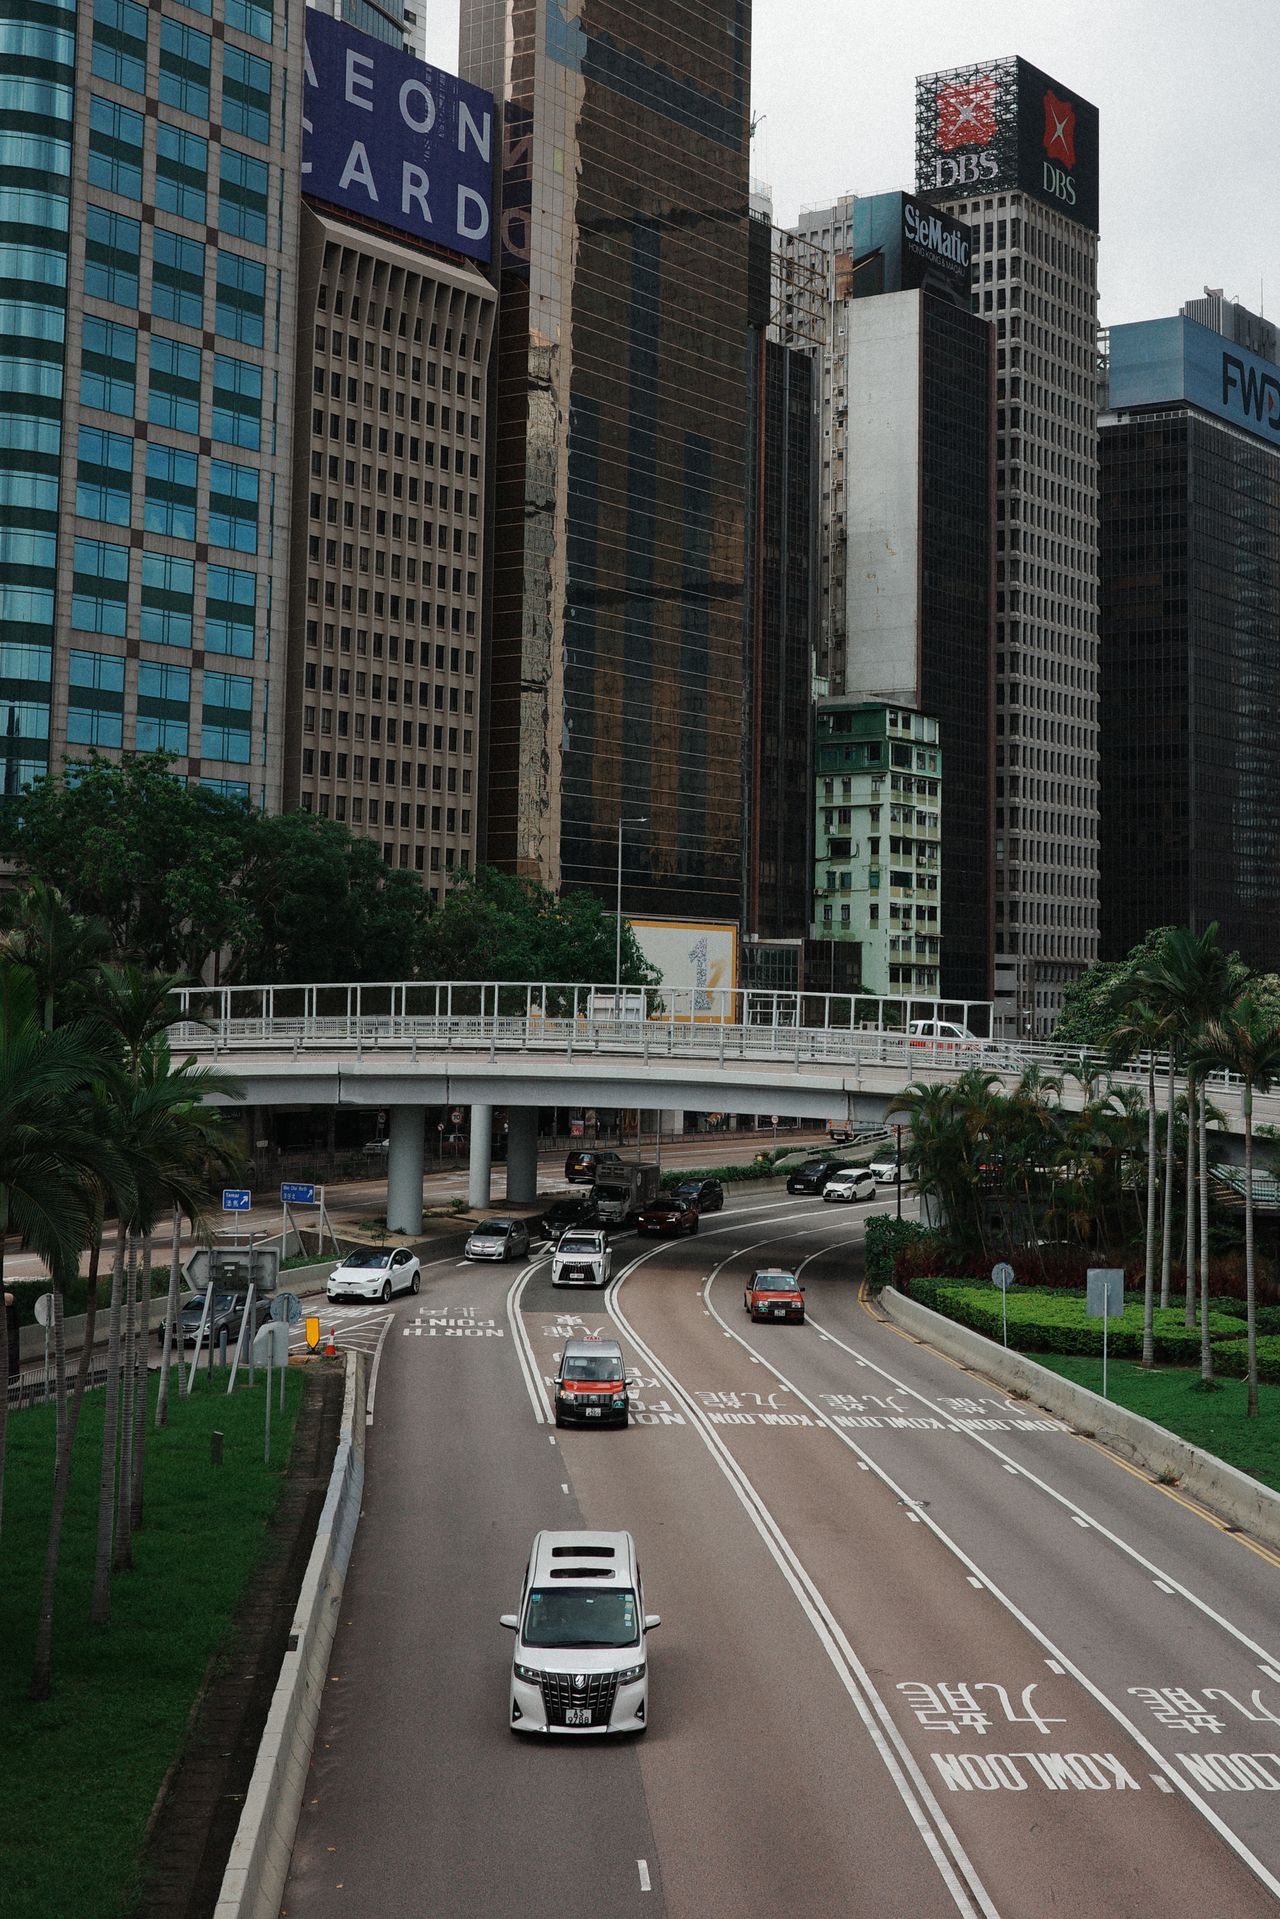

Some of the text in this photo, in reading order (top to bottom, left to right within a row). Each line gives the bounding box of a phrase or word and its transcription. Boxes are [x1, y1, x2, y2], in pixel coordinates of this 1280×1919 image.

[935, 150, 998, 188] DBS
[1043, 161, 1076, 206] DBS
[904, 204, 969, 267] SieMatic
[1223, 351, 1280, 430] FWD
[402, 1328, 504, 1337] NORTH
[409, 1318, 495, 1327] POINT
[694, 1391, 788, 1409] 九龍
[819, 1393, 908, 1413] 九龍
[707, 1412, 815, 1427] KOWLOON
[832, 1415, 946, 1430] KOWLOON
[956, 1418, 1075, 1433] KOWLOON
[896, 1682, 1067, 1734] 九龍
[930, 1753, 1142, 1791] KOWLOON
